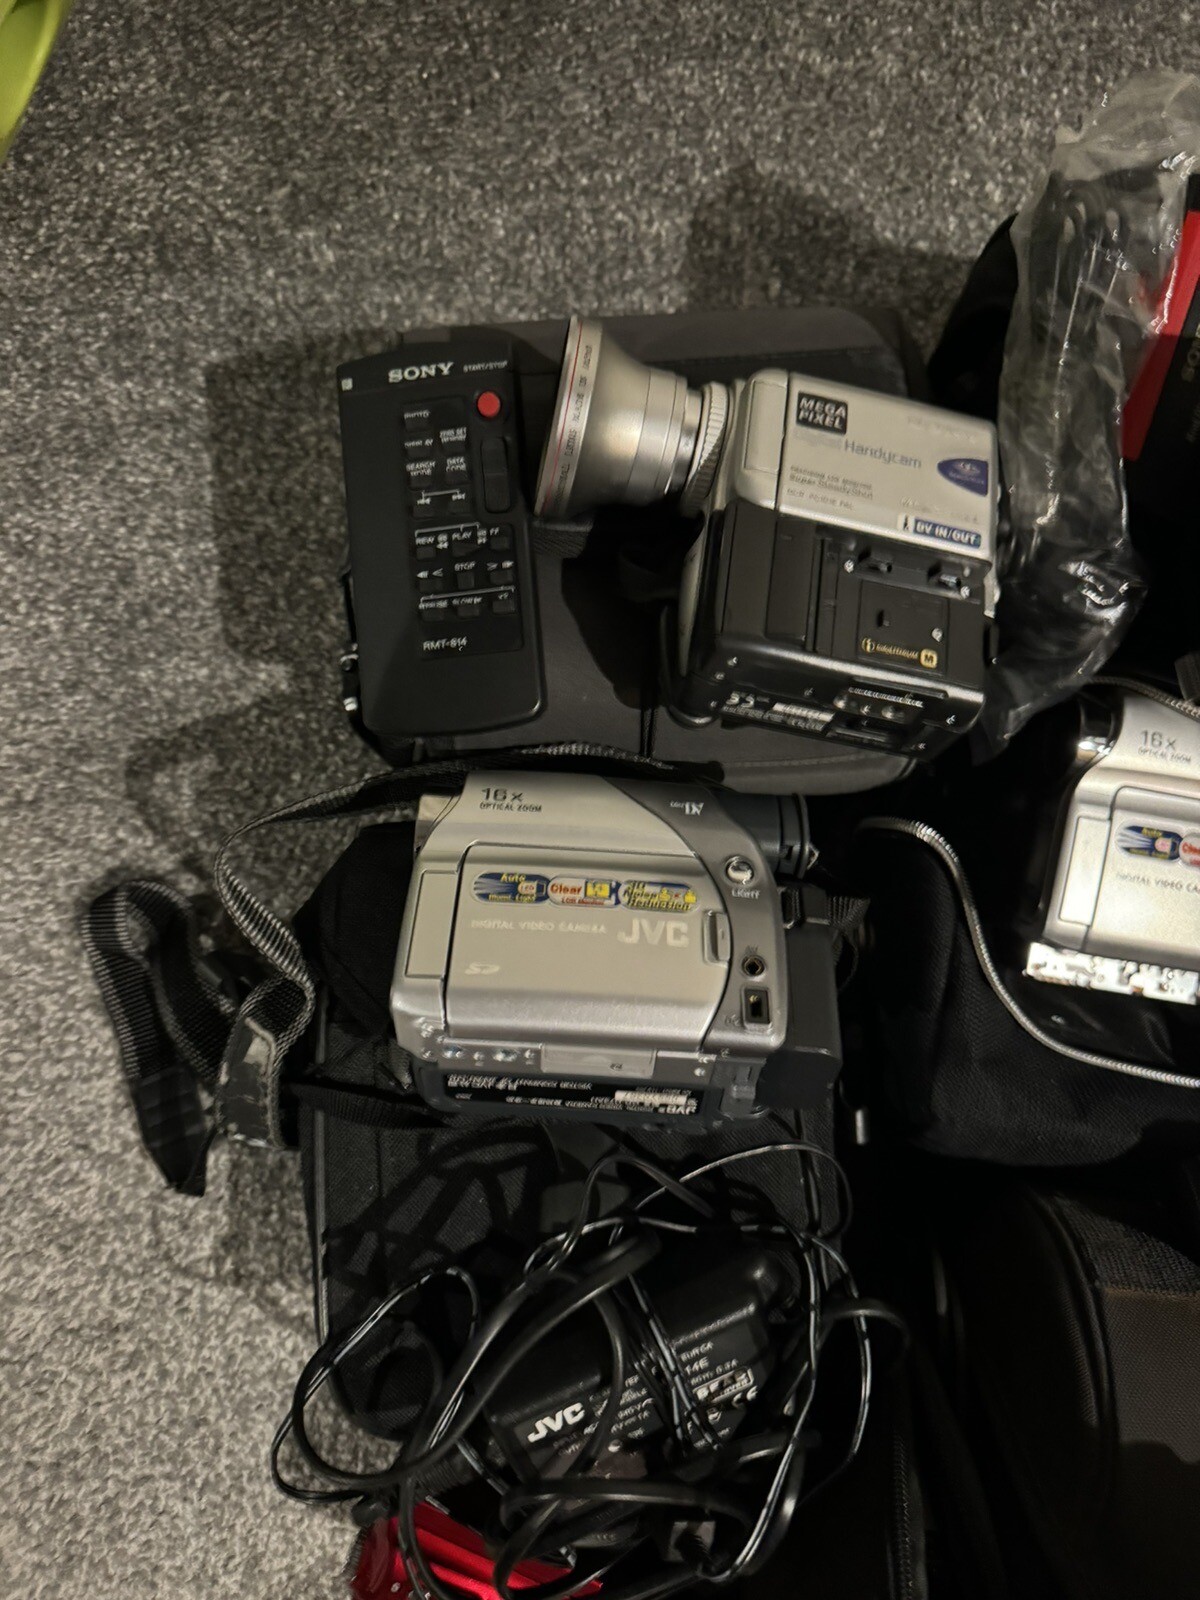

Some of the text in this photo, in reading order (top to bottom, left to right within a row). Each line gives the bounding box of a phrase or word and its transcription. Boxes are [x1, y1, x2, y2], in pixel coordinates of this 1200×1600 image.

[388, 361, 454, 383] SONY
[800, 396, 847, 418] MEGA
[800, 410, 843, 430] PIXEL
[844, 440, 922, 468] Handycam
[406, 461, 436, 471] SEARCH
[415, 531, 472, 545] REW PLAY
[916, 519, 978, 545] DV IN/OUT
[454, 561, 476, 571] STOP
[423, 637, 468, 651] RMT-814
[1141, 730, 1177, 751] 16x
[480, 787, 524, 802] 16x
[479, 801, 542, 813] OPTICAL ZOOM
[500, 873, 525, 884] Auto
[1154, 879, 1183, 891] VIDEO
[550, 882, 582, 895] Clear
[731, 889, 760, 900] LIGHT
[518, 920, 555, 932] VIDEO
[559, 923, 607, 935] CAMERA
[617, 920, 689, 948] JVC
[527, 1401, 585, 1443] JVC
